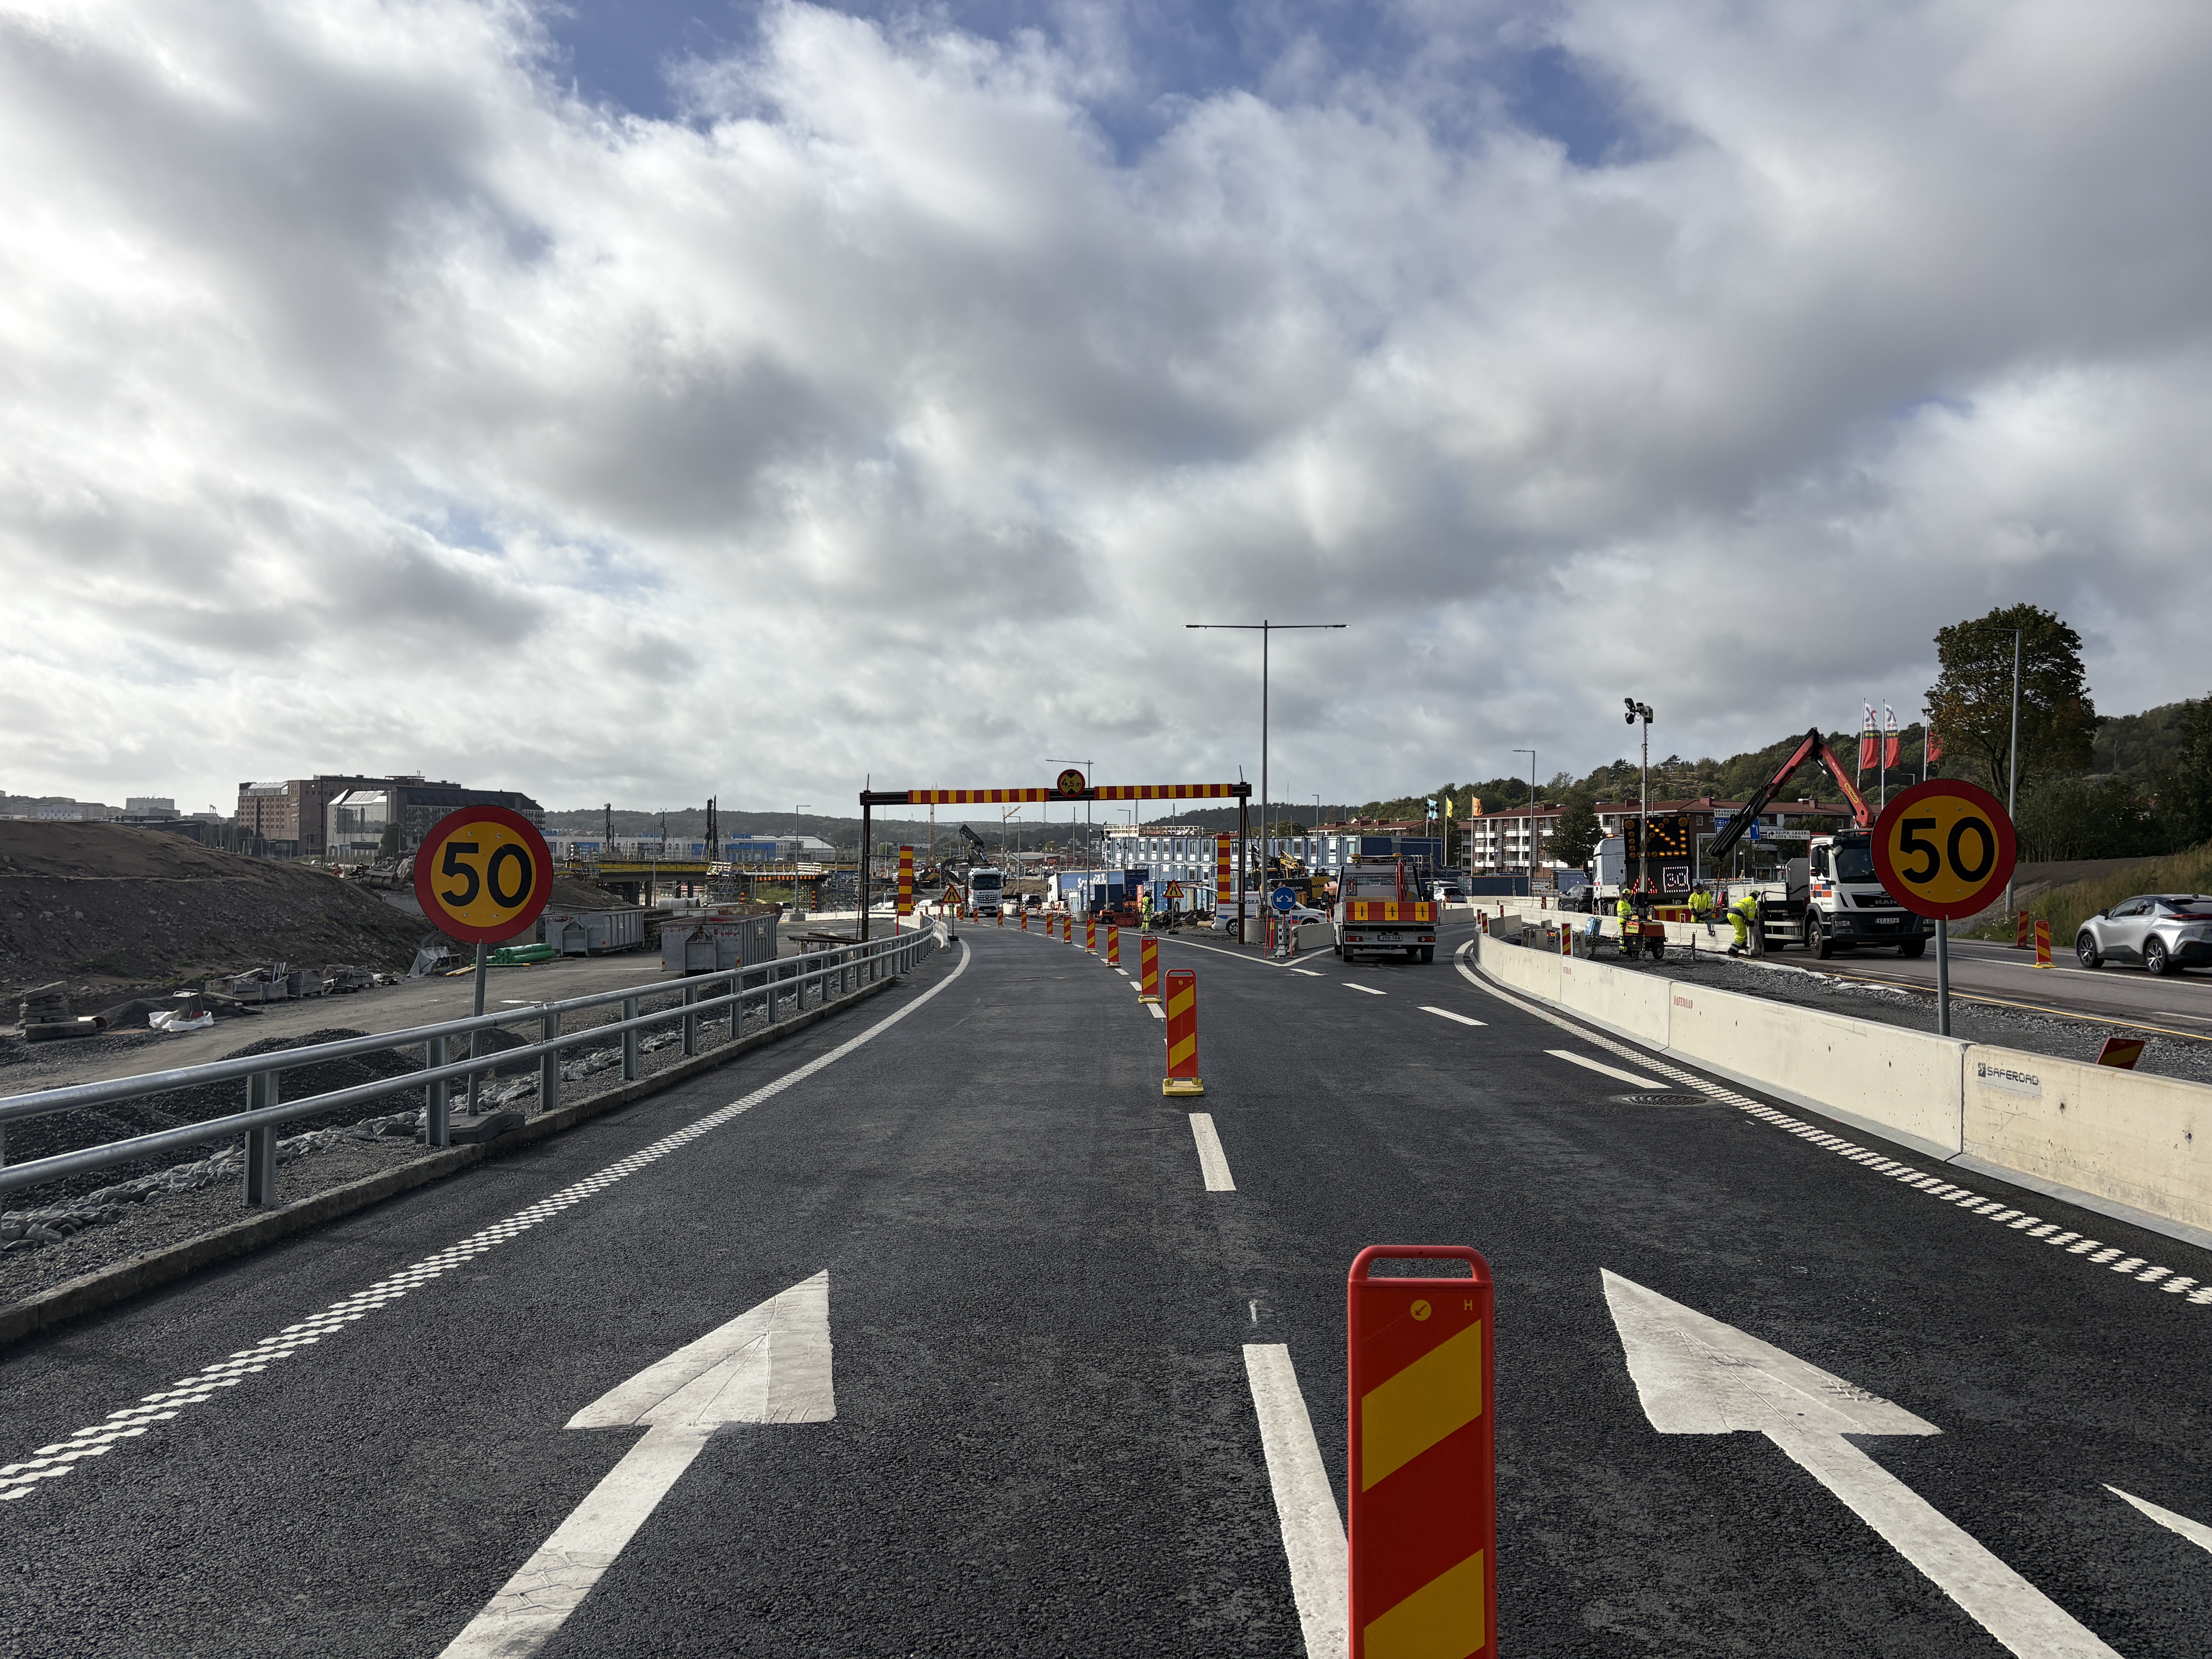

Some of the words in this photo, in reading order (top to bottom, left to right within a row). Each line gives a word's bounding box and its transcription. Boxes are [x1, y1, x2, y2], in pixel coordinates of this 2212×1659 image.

[1061, 778, 1074, 788] 4,5
[1899, 816, 1995, 884] 50
[441, 842, 532, 908] 50
[1674, 996, 1693, 1009] SAFEROAD
[1987, 1066, 2039, 1085] SAFEROAD
[1464, 1300, 1473, 1311] H
